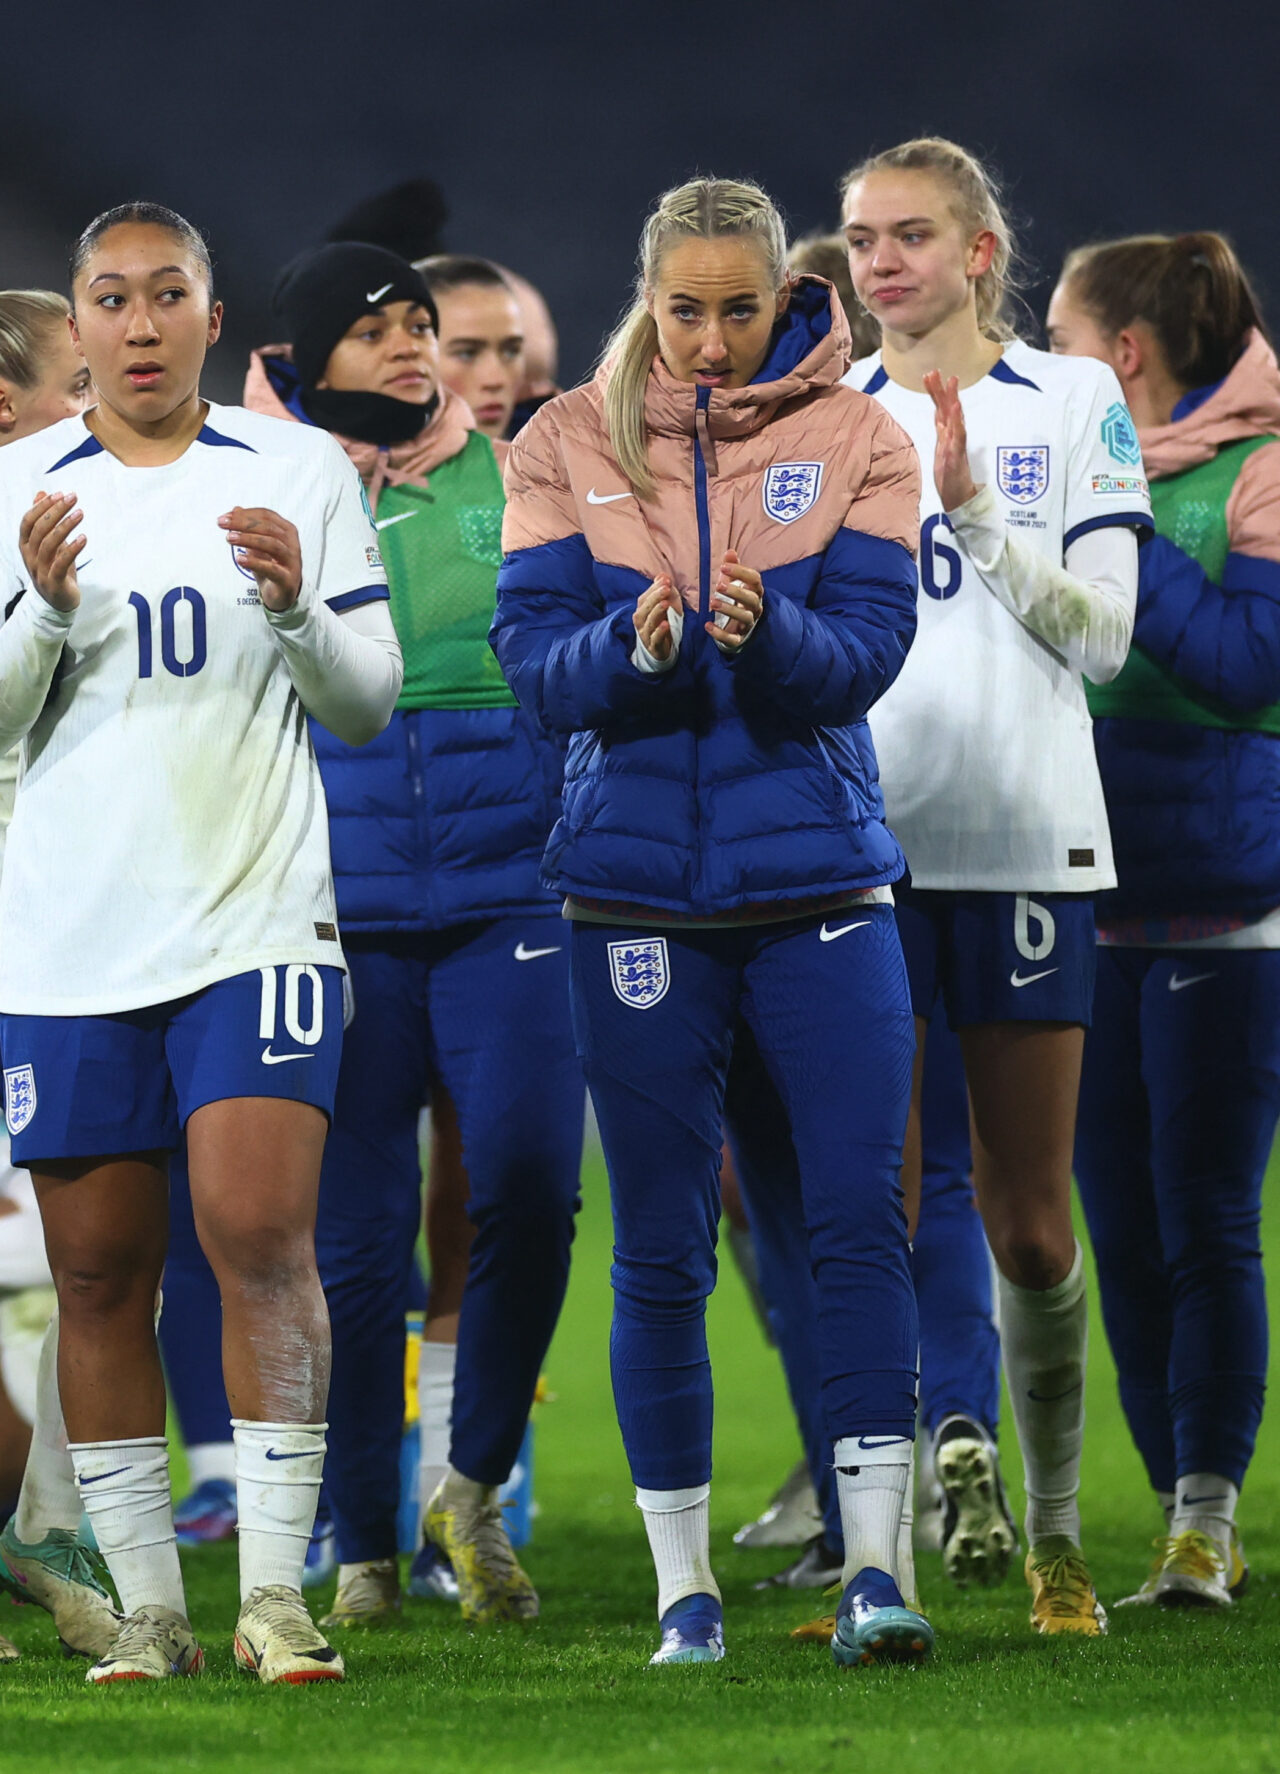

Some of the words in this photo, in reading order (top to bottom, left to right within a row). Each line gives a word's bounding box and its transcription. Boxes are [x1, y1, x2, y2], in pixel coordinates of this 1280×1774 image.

[1010, 510, 1037, 519] SCOTLAND
[1032, 521, 1047, 529] 2023
[920, 512, 962, 600] 6
[128, 586, 207, 679] 10
[1014, 892, 1055, 961] 6
[259, 964, 324, 1046] 10
